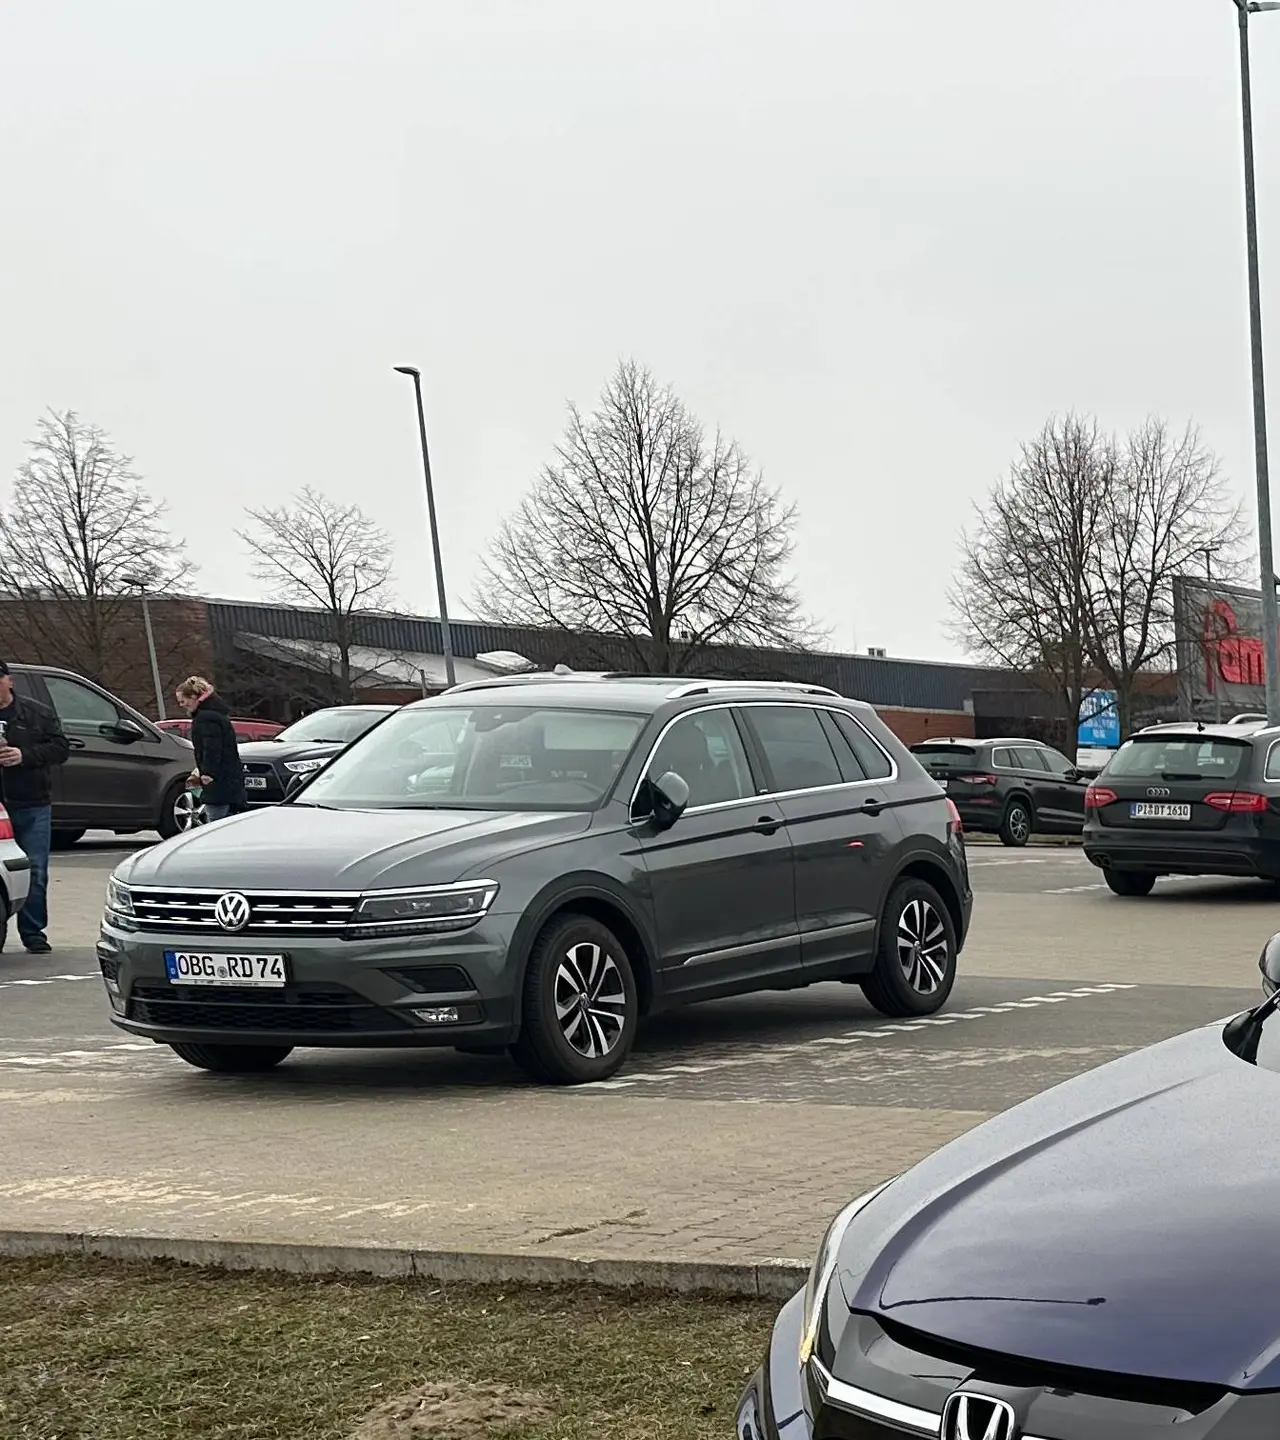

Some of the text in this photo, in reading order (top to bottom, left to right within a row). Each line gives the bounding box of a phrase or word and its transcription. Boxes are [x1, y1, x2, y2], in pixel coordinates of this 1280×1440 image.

[1166, 805, 1189, 816] 1610
[178, 954, 216, 977] OBG
[256, 957, 283, 979] 74
